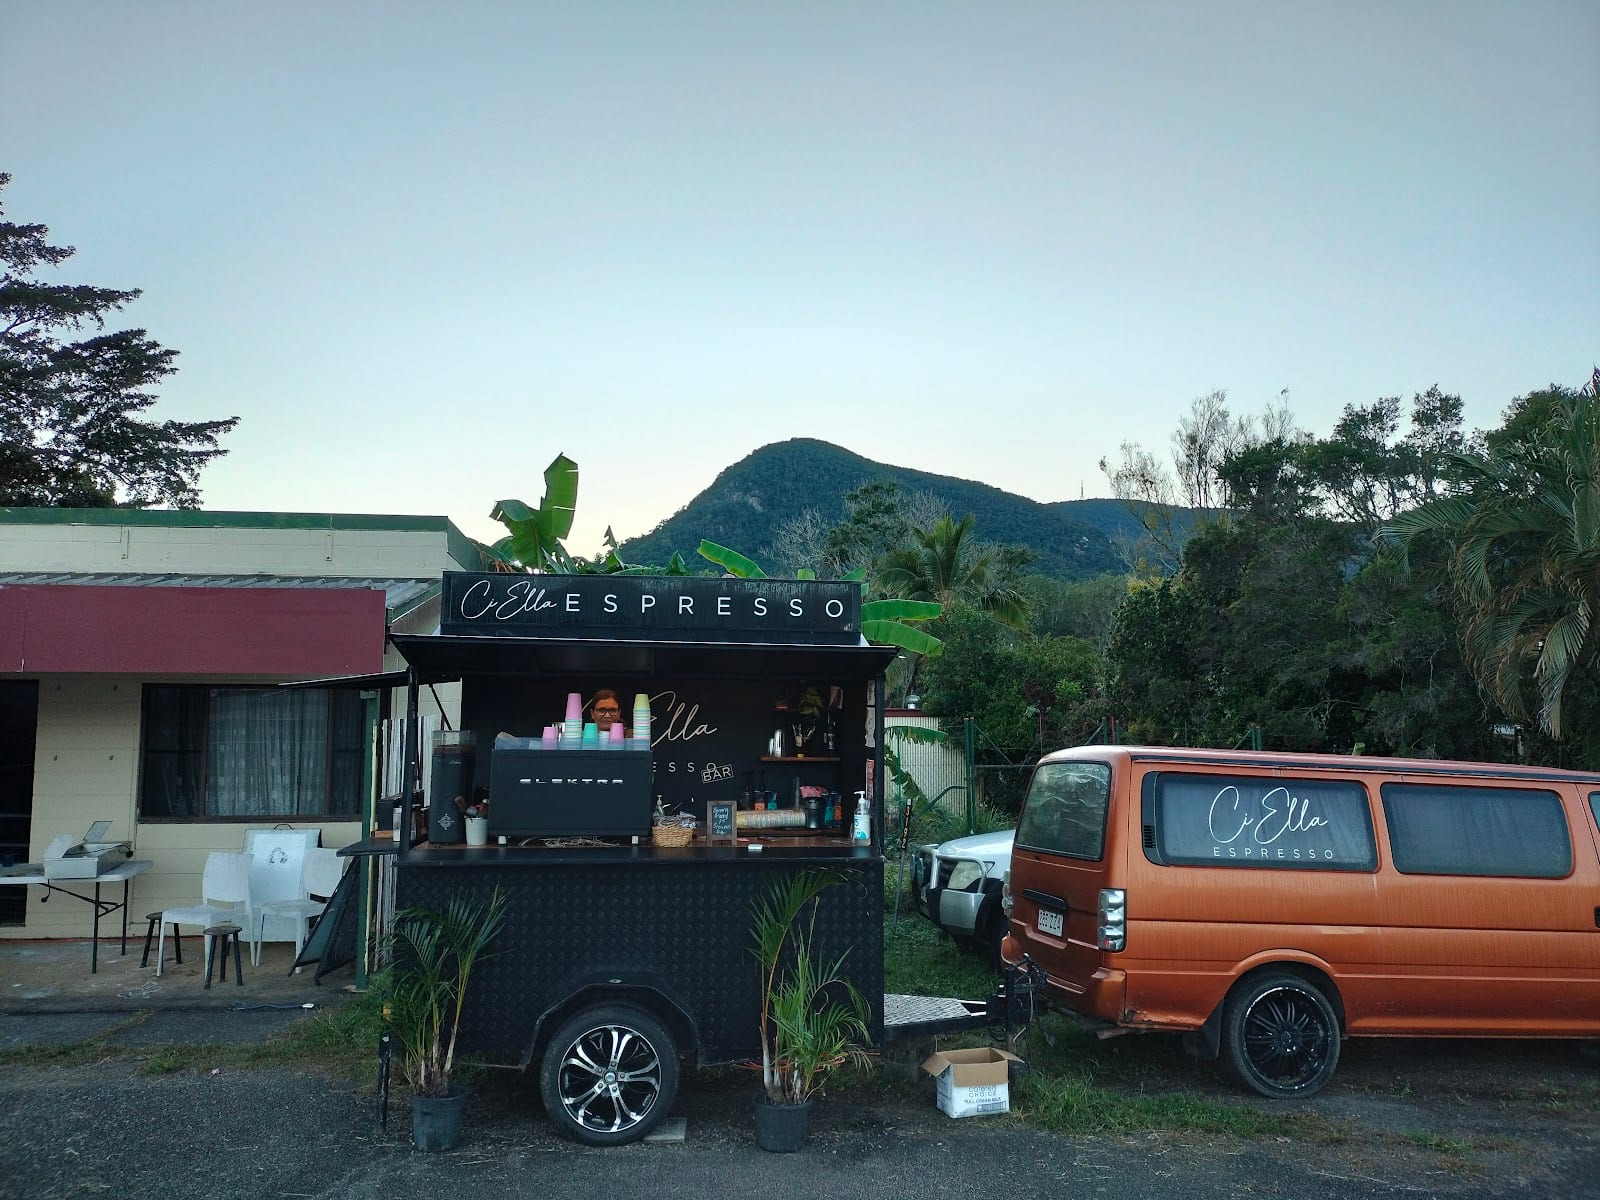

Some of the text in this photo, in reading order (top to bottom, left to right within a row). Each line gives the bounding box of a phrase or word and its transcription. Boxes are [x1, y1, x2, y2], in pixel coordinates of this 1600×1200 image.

[565, 592, 844, 618] ESPRESSO
[702, 766, 732, 782] BAR
[1254, 786, 1328, 845] Ella
[1213, 846, 1333, 859] ESPRESSO
